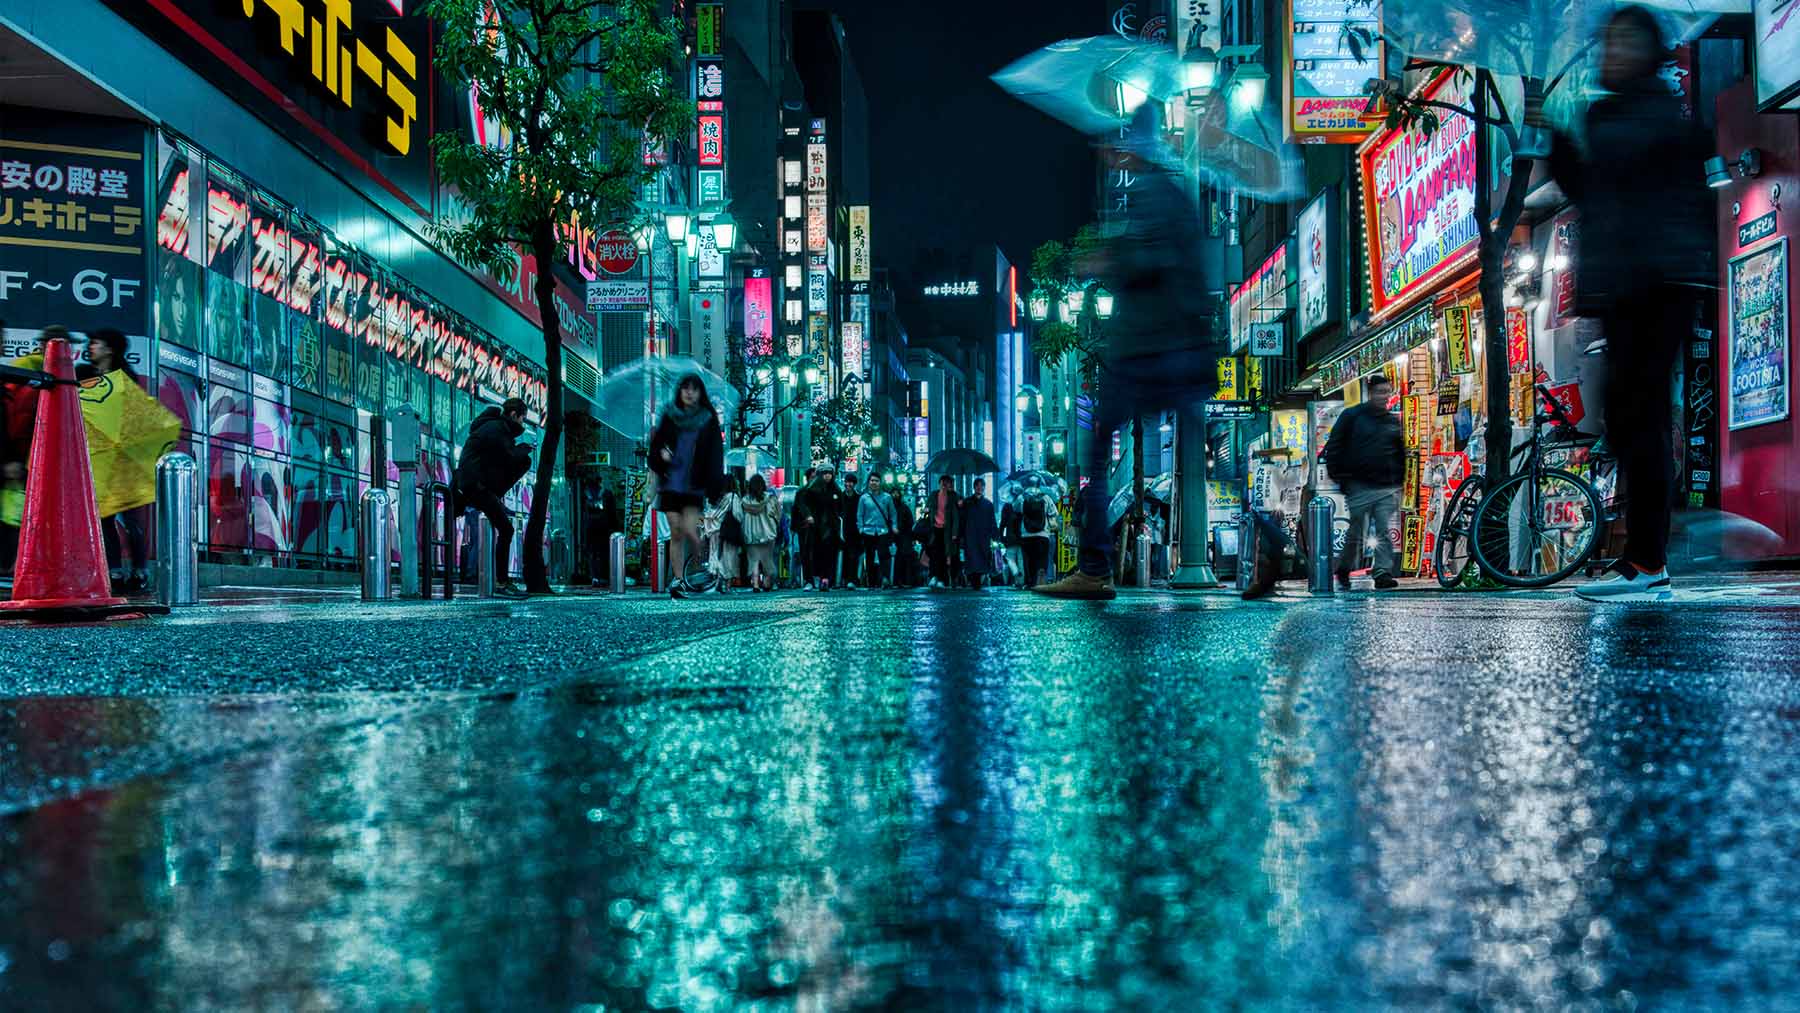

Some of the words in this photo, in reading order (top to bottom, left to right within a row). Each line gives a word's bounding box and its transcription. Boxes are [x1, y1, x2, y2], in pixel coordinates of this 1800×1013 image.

[703, 122, 720, 155] 焼肉
[1740, 216, 1775, 242] ワールドビル
[600, 243, 635, 260] 消火栓
[811, 256, 826, 265] 5F
[588, 287, 648, 297] つるかめクリニック
[853, 283, 868, 292] 4F
